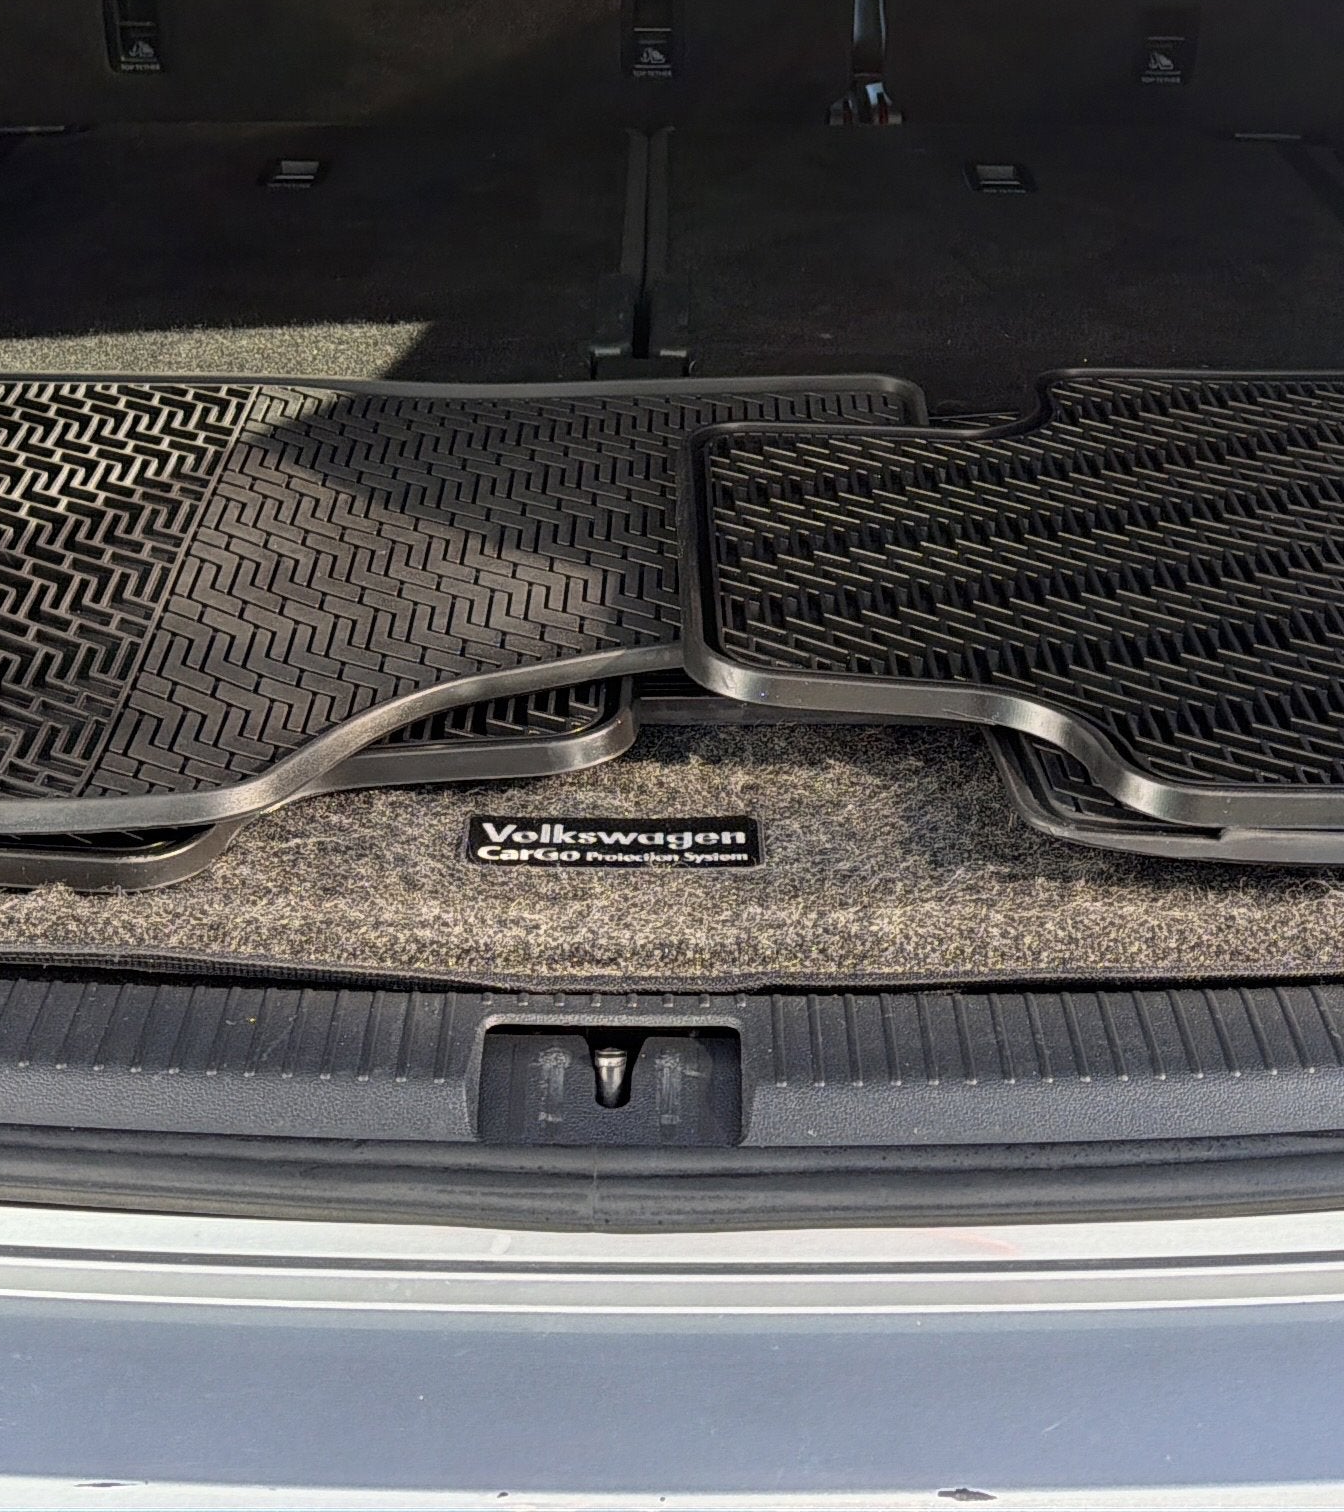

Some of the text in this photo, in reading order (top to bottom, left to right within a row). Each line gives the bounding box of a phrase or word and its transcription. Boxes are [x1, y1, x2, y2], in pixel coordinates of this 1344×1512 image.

[482, 822, 746, 849] Volkswagen
[586, 851, 679, 862] Protection
[683, 852, 748, 864] System
